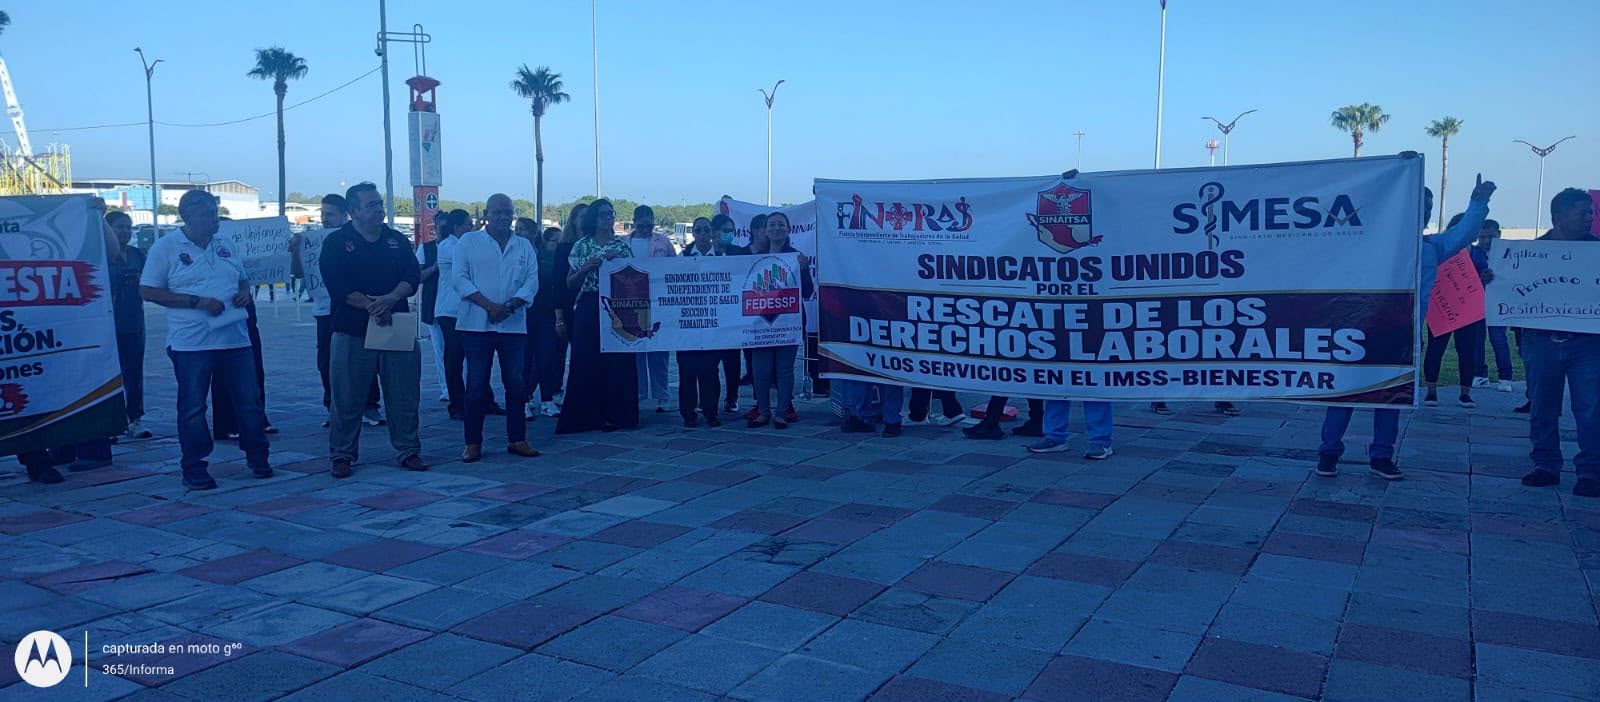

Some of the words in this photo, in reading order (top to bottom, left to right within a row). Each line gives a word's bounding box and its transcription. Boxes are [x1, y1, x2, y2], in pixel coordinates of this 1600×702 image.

[1039, 216, 1089, 224] SINAITSA
[1173, 186, 1363, 247] SIMESA
[918, 254, 1103, 282] SINDICATOS
[1111, 250, 1245, 281] UNIDOS
[1503, 248, 1550, 270] Agilizar
[1562, 251, 1572, 261] el
[664, 273, 700, 283] SINDICATO
[700, 272, 732, 281] NACIONAL
[667, 284, 720, 294] INDEPENDIENTE
[721, 283, 730, 293] DE
[1036, 283, 1072, 296] POR
[1077, 284, 1099, 296] EL
[658, 296, 708, 306] TRABAJADORES
[709, 296, 718, 305] DE
[719, 295, 739, 304] SALUD
[745, 296, 796, 310] FEDESSP
[907, 295, 1088, 330] RESCATE
[1103, 301, 1162, 330] DE
[1178, 298, 1267, 327] LOS
[850, 316, 1057, 361] DERECHOS
[1069, 328, 1366, 362] LABORALES
[866, 352, 877, 366] Y
[881, 355, 914, 373] LOS
[919, 360, 1027, 384] SERVICIOS
[1033, 370, 1064, 385] EN
[1071, 370, 1098, 387] EL
[1105, 369, 1335, 390] IMSS-BIENESTAR
